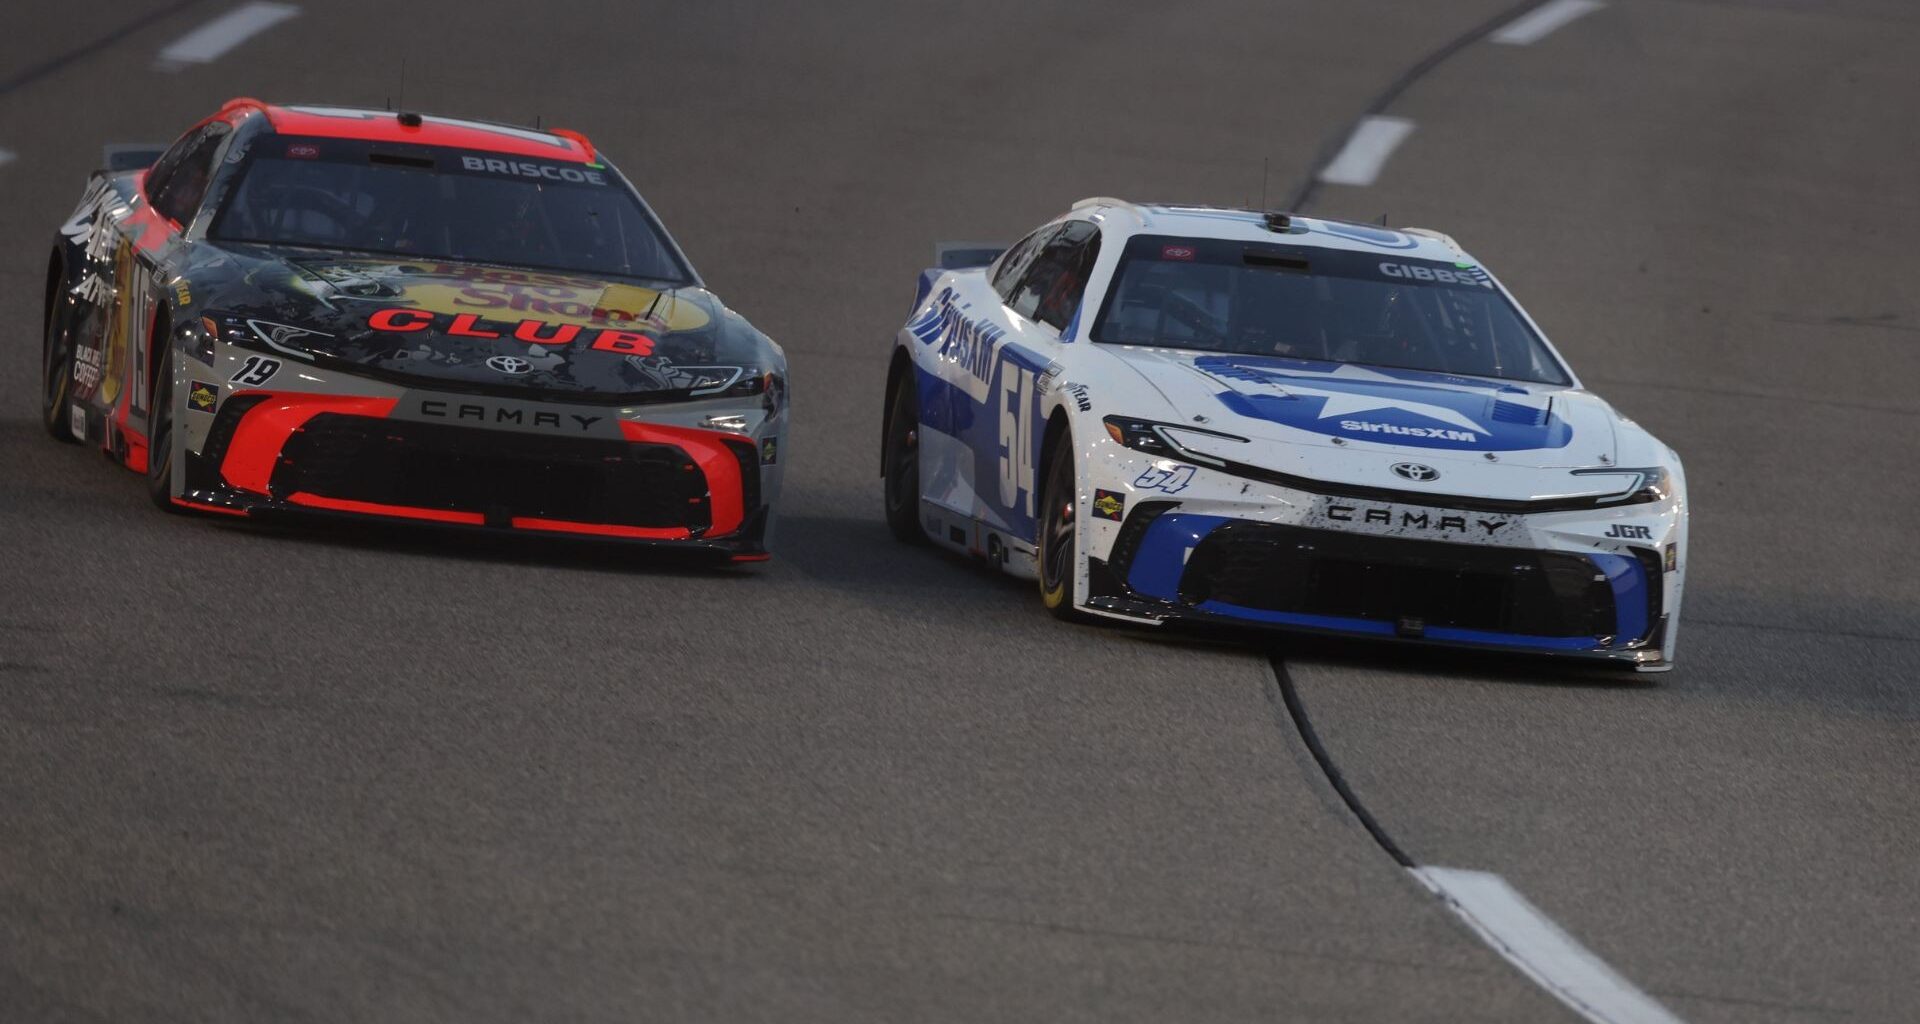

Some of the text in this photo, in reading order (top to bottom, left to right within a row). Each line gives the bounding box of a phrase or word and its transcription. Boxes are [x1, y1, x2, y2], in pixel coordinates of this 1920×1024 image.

[461, 155, 607, 186] BRISCOE
[1378, 262, 1477, 286] GIBBS
[367, 308, 656, 357] CLUB
[231, 355, 281, 387] 19
[421, 400, 603, 430] CAMRY
[1000, 360, 1036, 518] 54
[1340, 420, 1477, 443] SiriusXM
[1133, 466, 1197, 494] 54
[1327, 505, 1507, 535] CAMRY
[1605, 524, 1653, 540] JGR
